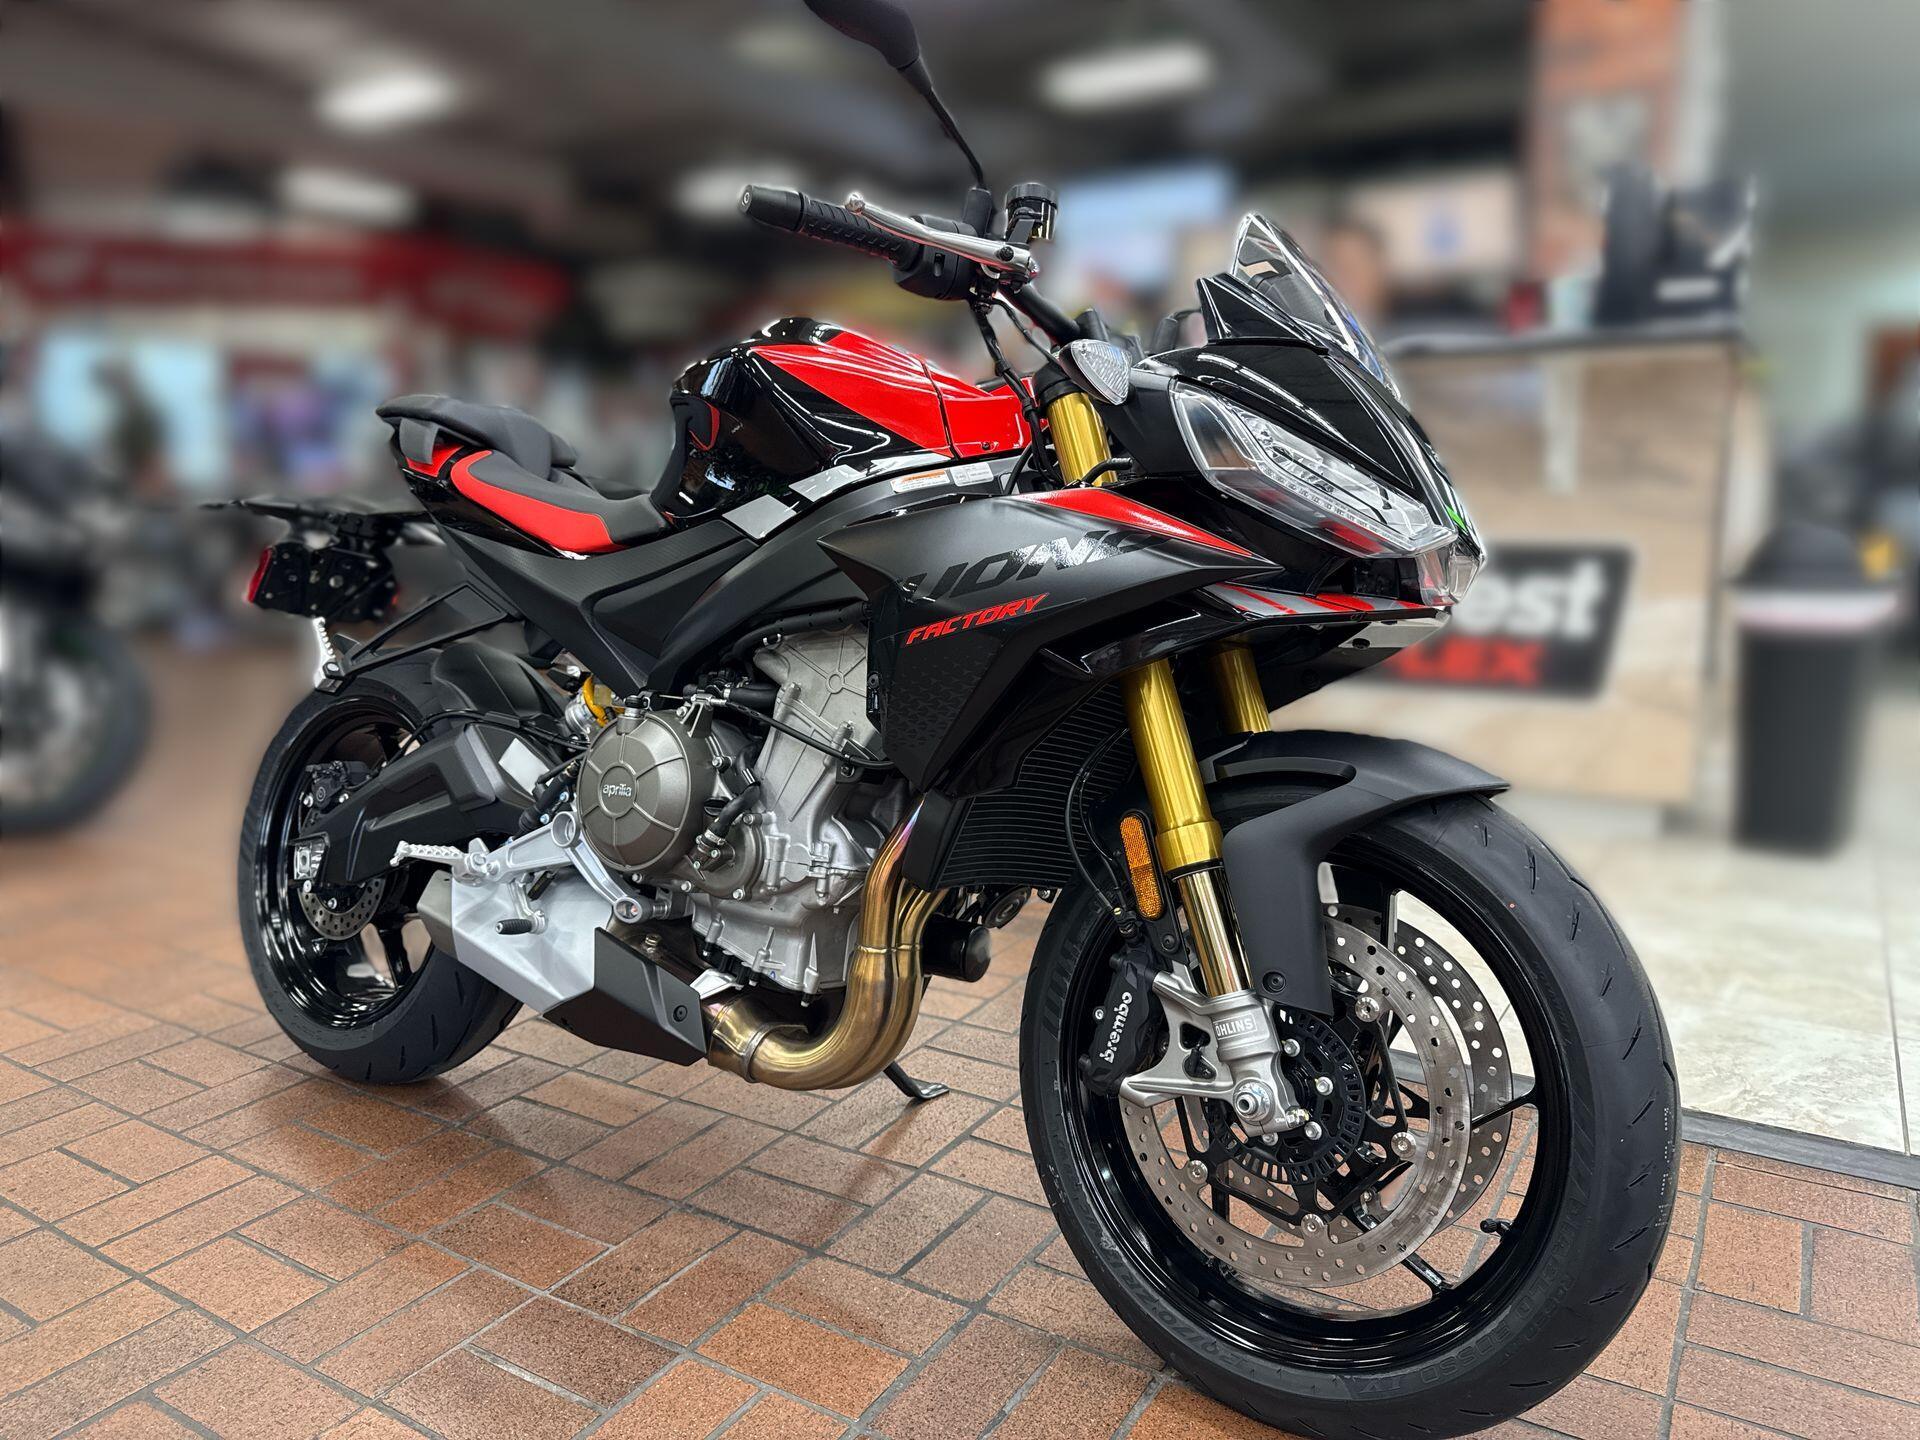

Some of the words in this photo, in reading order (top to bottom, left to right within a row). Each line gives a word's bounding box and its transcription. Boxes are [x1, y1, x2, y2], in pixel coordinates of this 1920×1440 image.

[905, 593, 1050, 647] FACTORY
[602, 783, 632, 797] aprilia
[1099, 991, 1133, 1064] brembo
